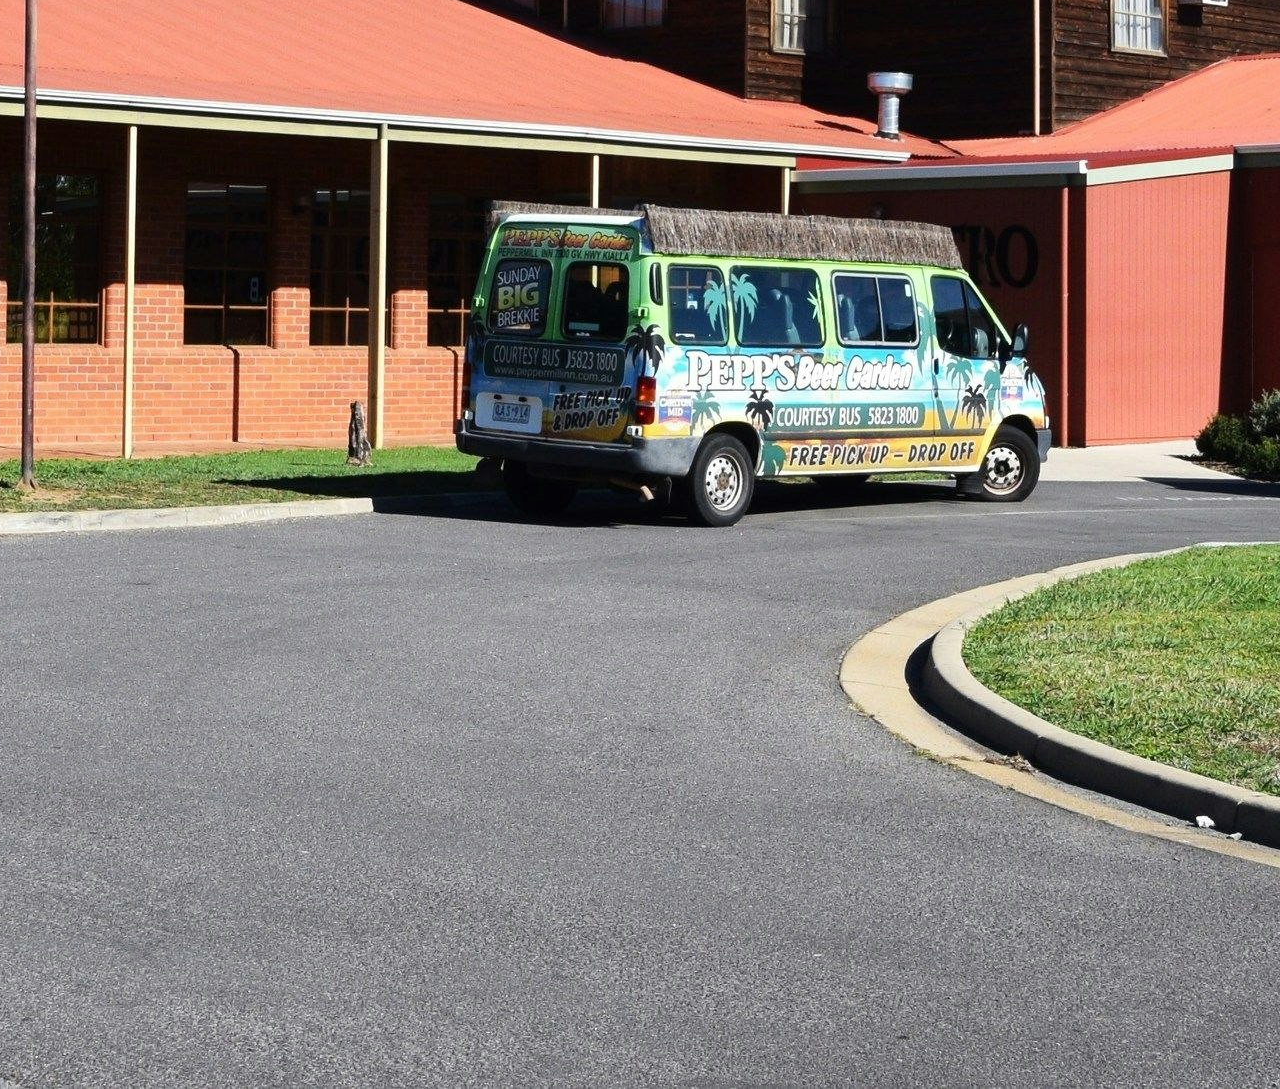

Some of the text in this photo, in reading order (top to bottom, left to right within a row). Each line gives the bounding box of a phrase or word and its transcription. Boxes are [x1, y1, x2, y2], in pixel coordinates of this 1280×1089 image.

[584, 250, 601, 260] HWY
[602, 251, 629, 261] KIALLA
[497, 266, 541, 286] SUNDAY
[498, 282, 540, 310] BIG
[498, 307, 540, 327] BREKKIE
[493, 345, 618, 372] COURTESY BUS 5823 1800
[685, 350, 913, 391] PEPP'S Beer Garden
[553, 392, 581, 411] FREE
[585, 388, 613, 409] PICK
[659, 397, 692, 407] CARLTON
[552, 408, 619, 432] & DROP OFF
[668, 407, 683, 416] MID
[776, 406, 919, 427] COURTESY BUS 5823 1800
[789, 446, 829, 466] FREE
[831, 445, 868, 466] PICK
[871, 445, 889, 464] UP
[907, 443, 947, 462] DROP
[950, 441, 975, 461] OFF
